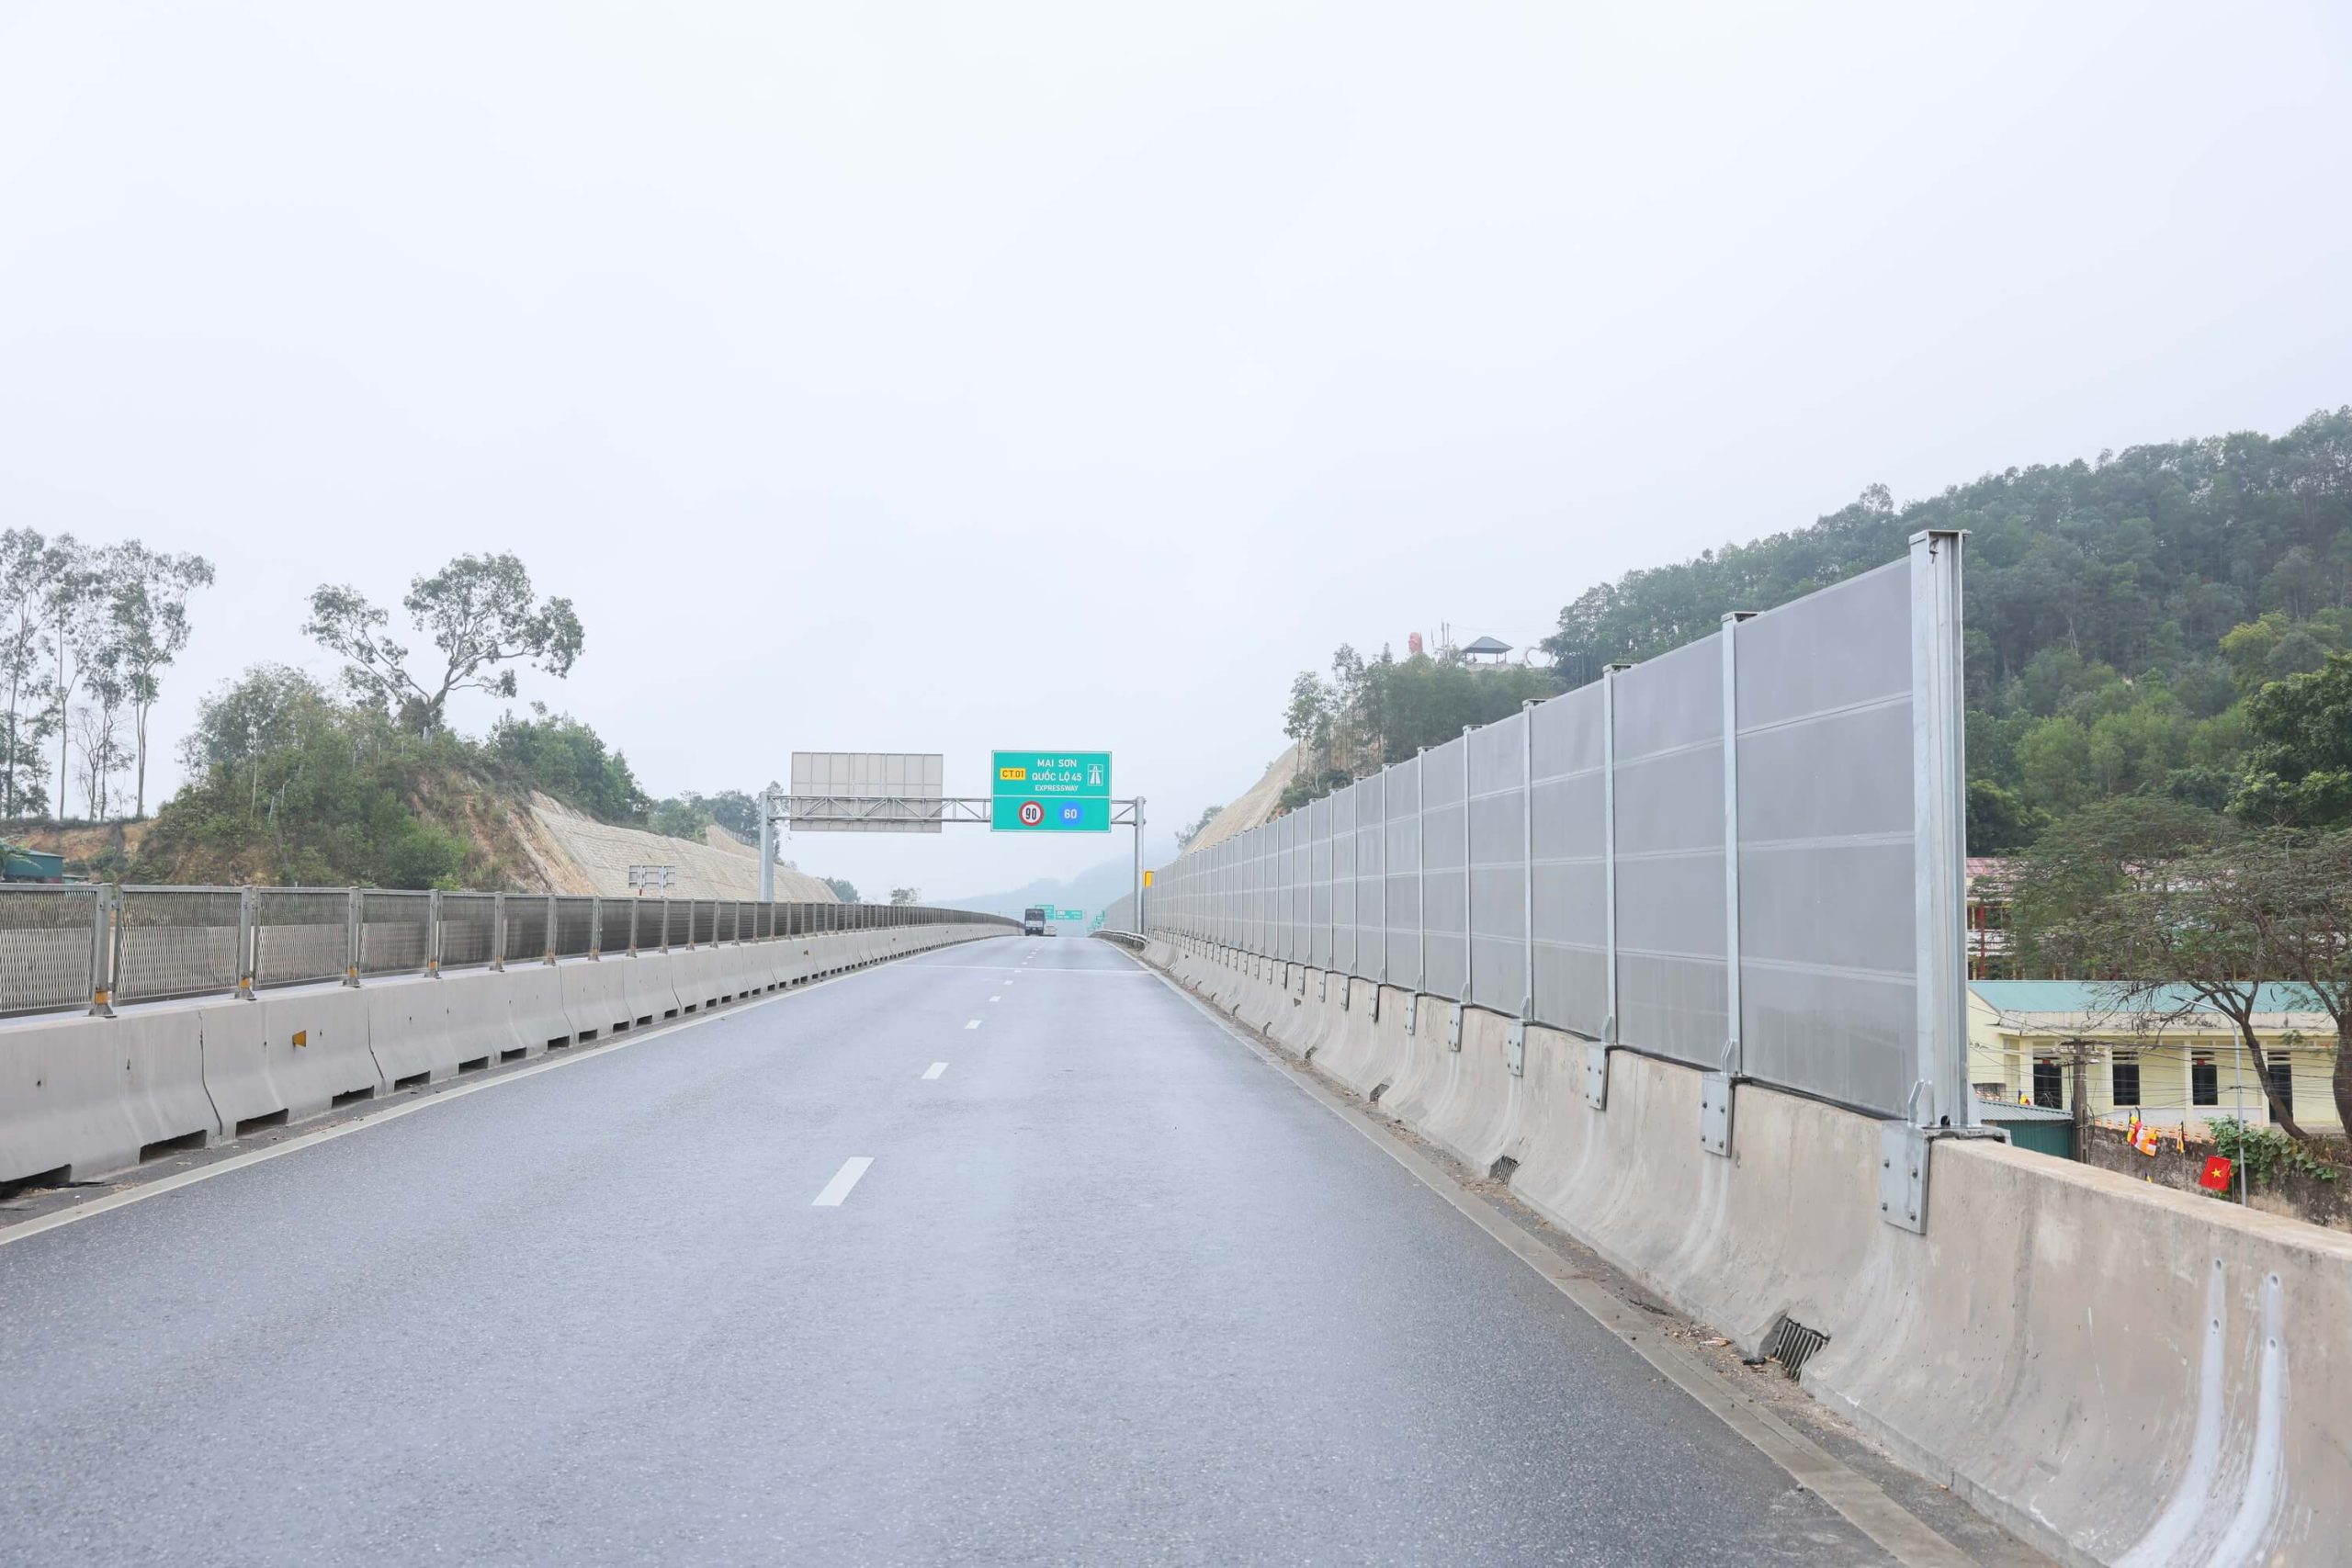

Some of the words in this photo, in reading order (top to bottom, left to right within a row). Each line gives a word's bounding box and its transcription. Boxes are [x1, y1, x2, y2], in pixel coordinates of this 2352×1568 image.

[1037, 759, 1054, 768] MAI
[1057, 759, 1077, 768] SƠN
[1032, 769, 1056, 781] QUỐC
[1058, 773, 1070, 783] LỘ
[1071, 773, 1082, 782] 45
[1025, 807, 1037, 820] 90
[1064, 808, 1078, 819] 60
